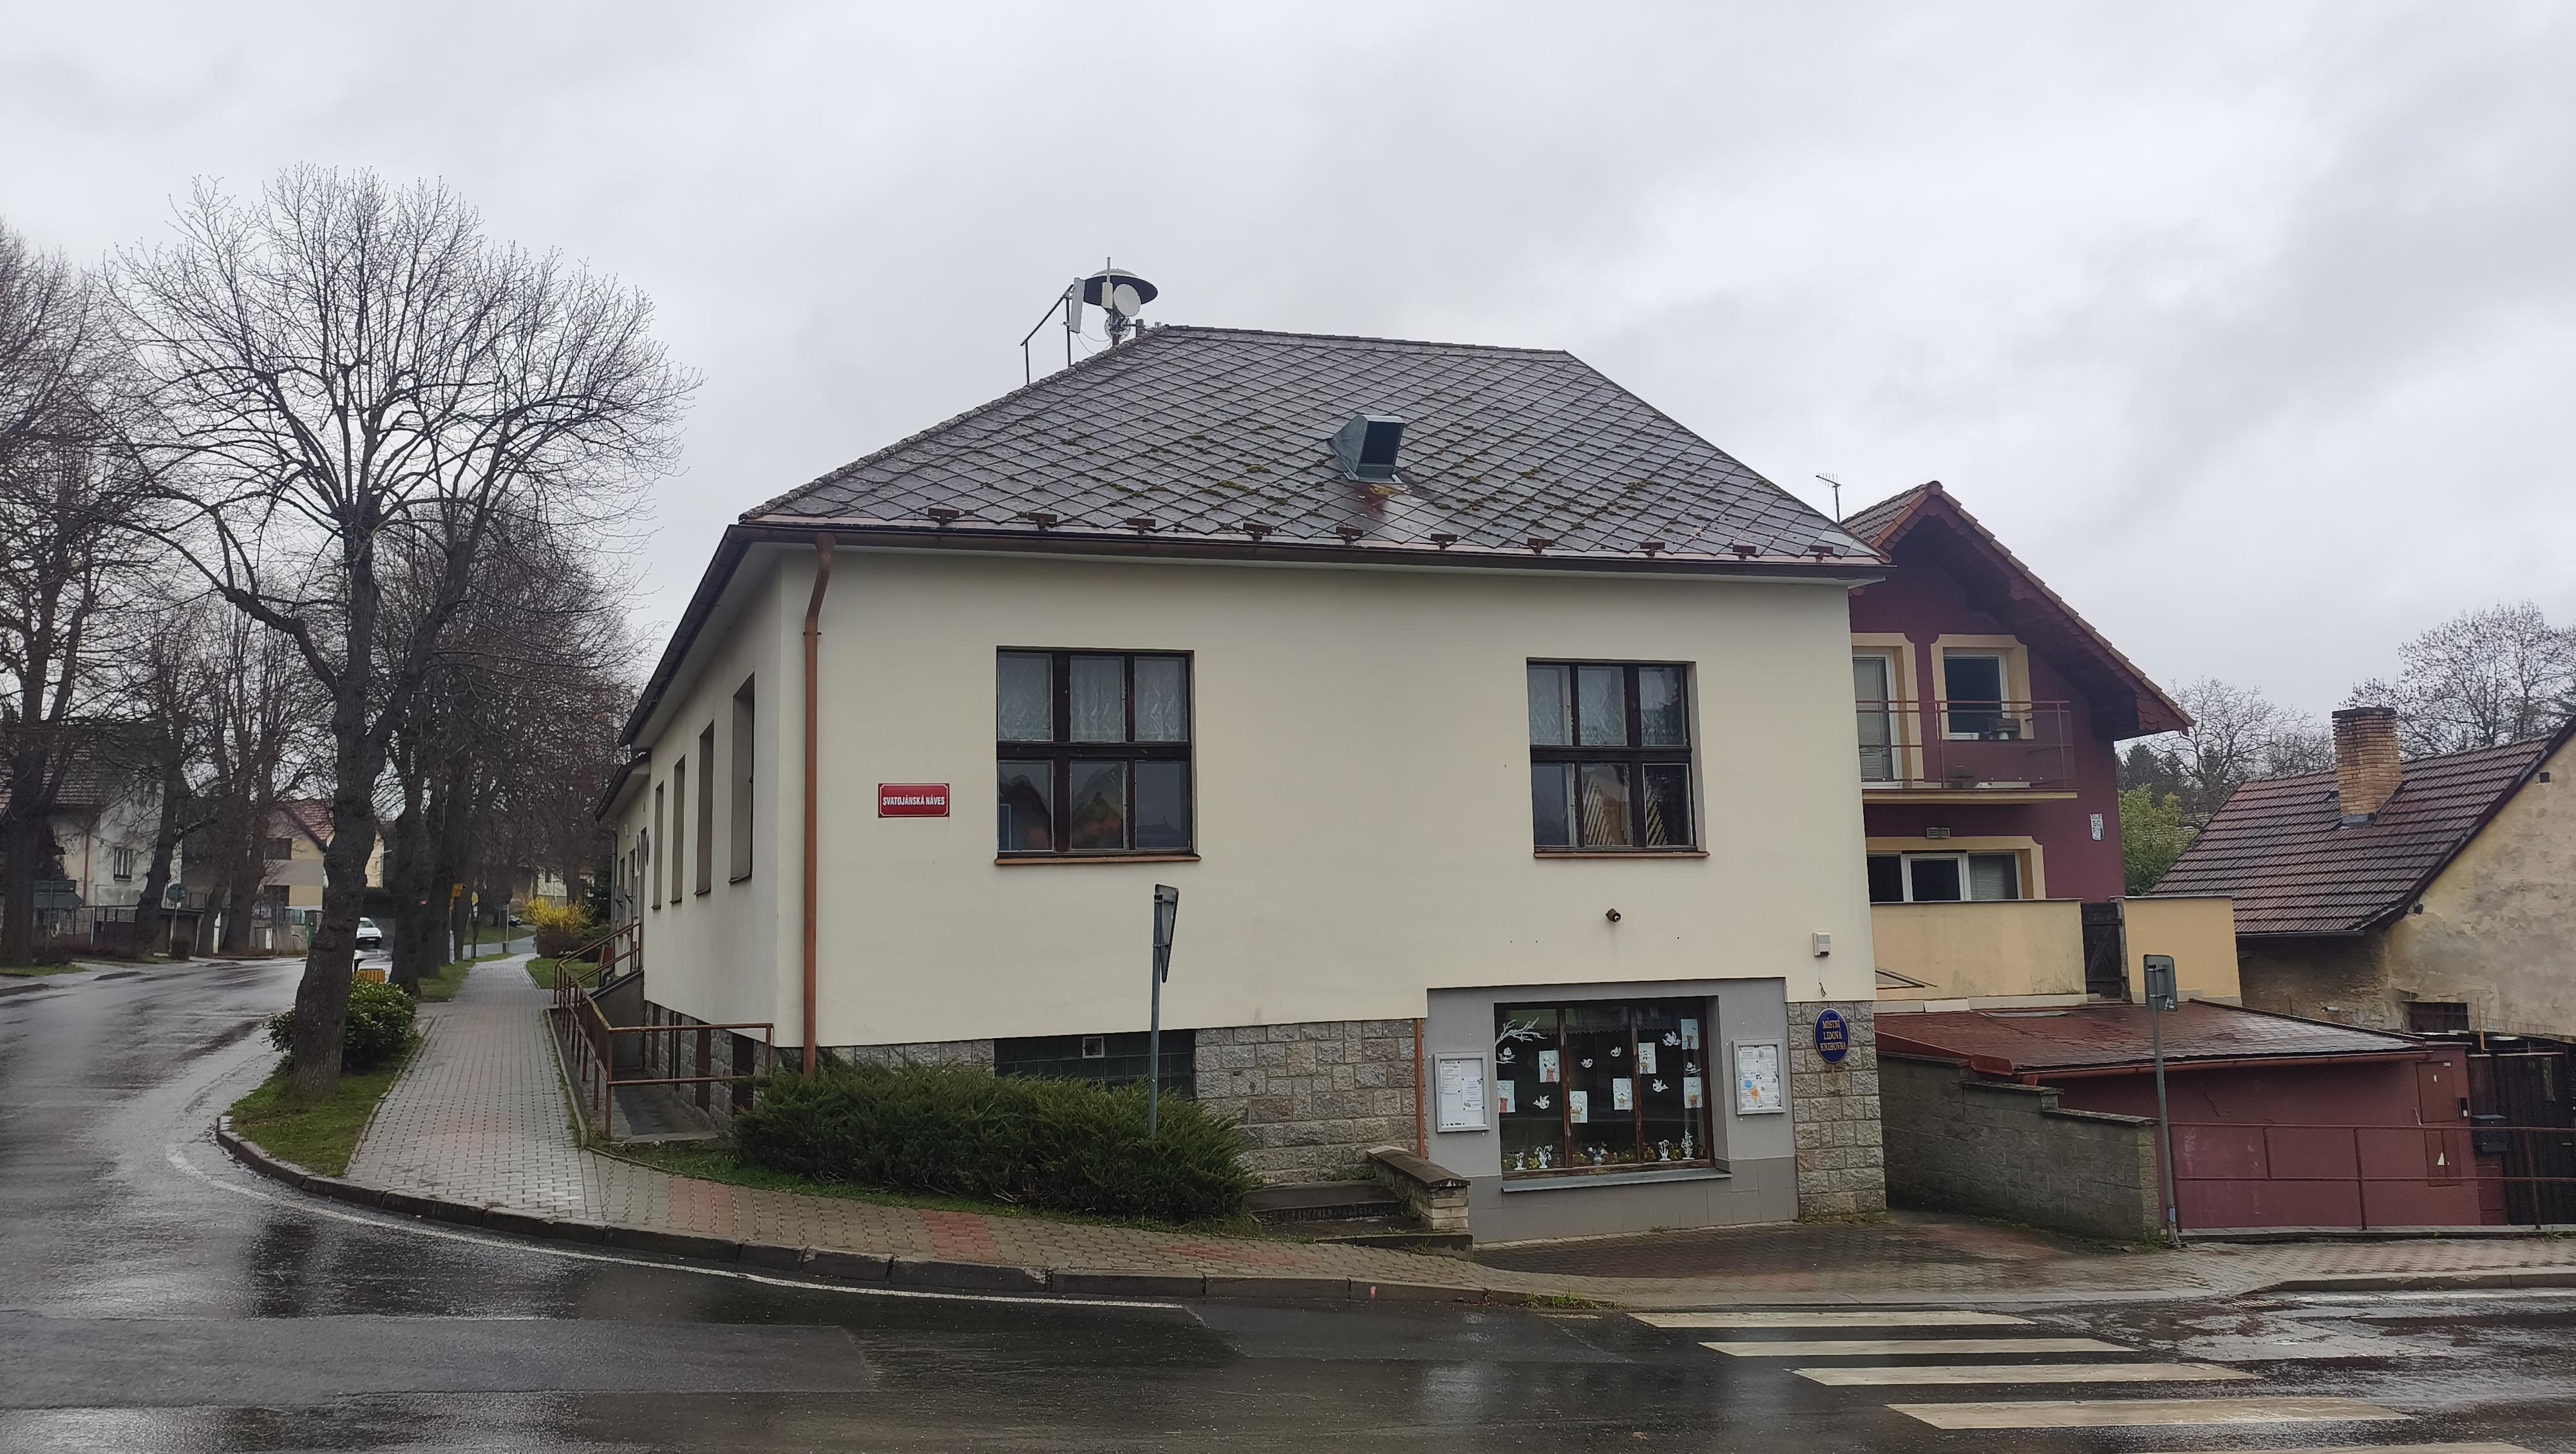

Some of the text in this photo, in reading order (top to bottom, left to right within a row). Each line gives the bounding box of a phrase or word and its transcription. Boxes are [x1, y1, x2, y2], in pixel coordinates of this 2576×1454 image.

[883, 794, 945, 806] SVATOJÁNSKÁ NÁVES
[1822, 1017, 1841, 1029] MÍSTNÍ
[1823, 1028, 1842, 1040] LIDOVÁ
[1820, 1041, 1846, 1052] KNIHOVNA
